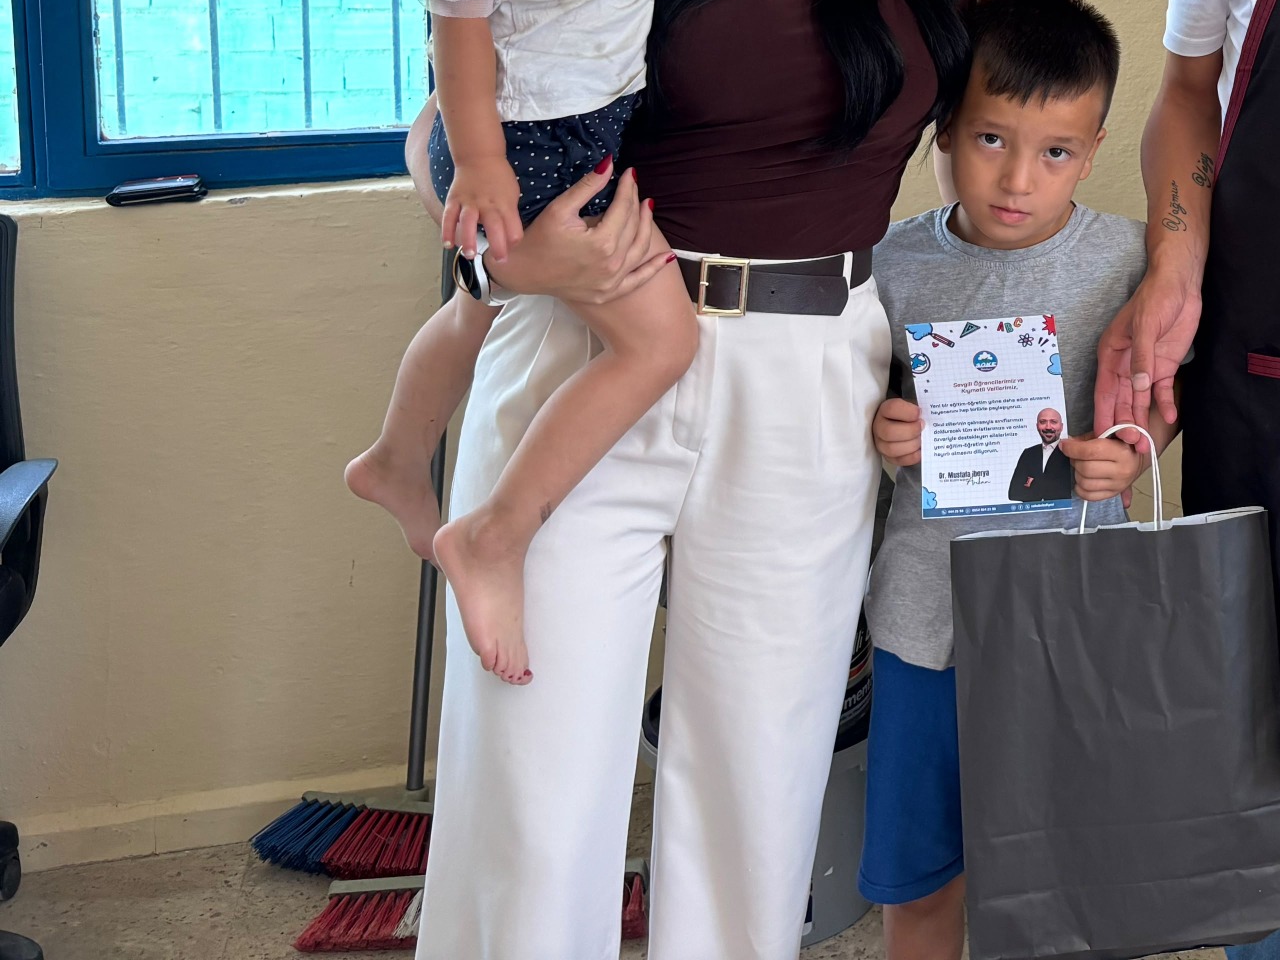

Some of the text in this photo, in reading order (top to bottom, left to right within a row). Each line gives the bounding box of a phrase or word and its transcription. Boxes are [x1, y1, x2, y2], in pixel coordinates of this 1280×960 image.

[953, 381, 973, 389] Sevgili
[973, 378, 1017, 387] Öğrencilerimiz
[961, 387, 986, 395] Kıymetli
[948, 470, 970, 479] Mustafa
